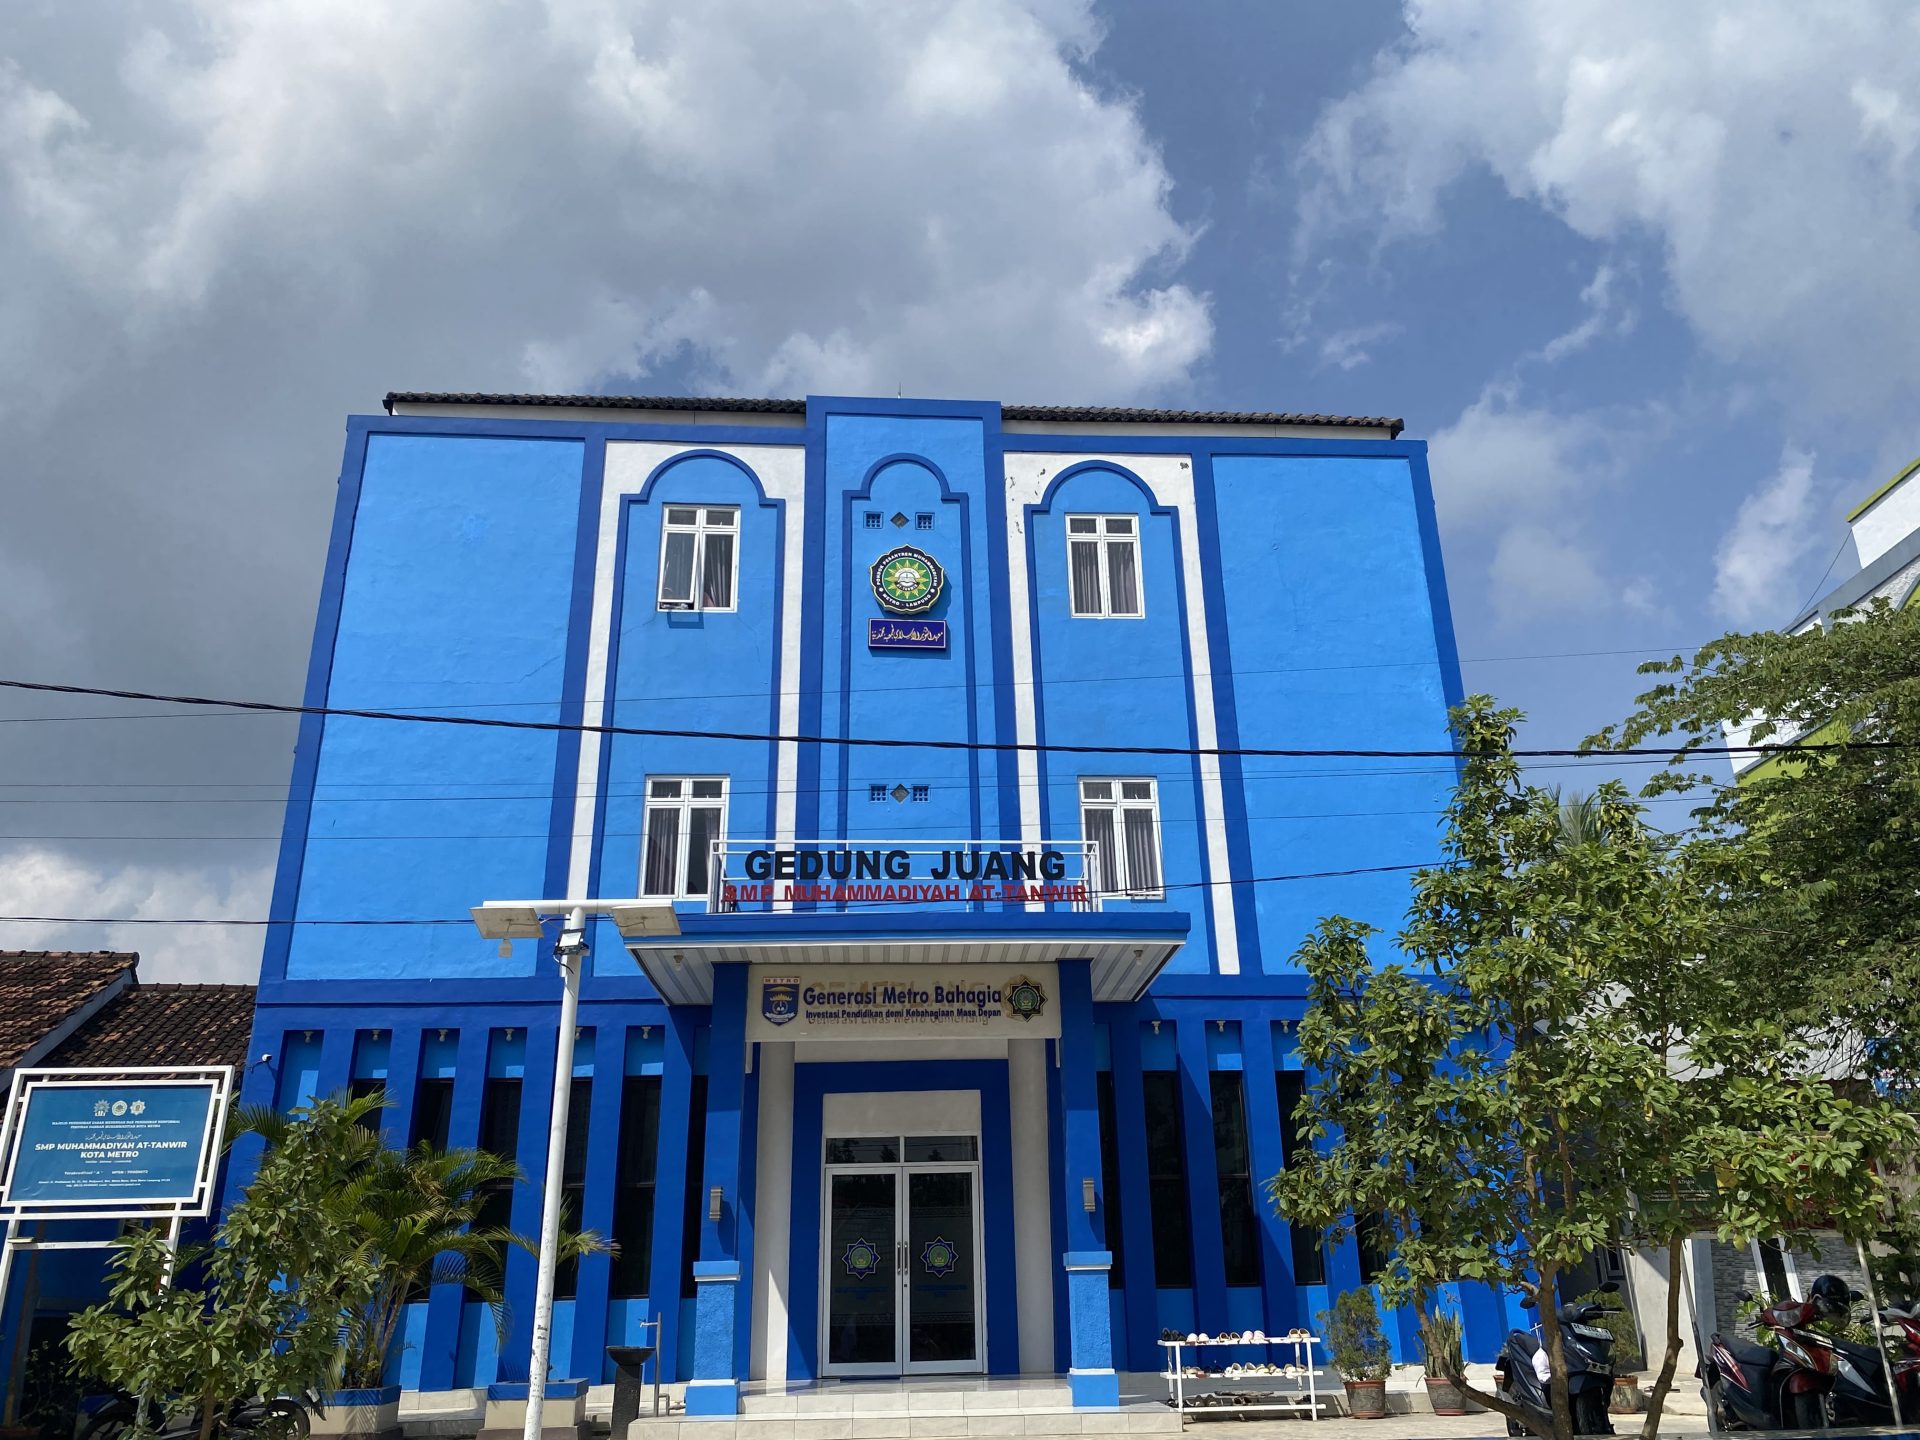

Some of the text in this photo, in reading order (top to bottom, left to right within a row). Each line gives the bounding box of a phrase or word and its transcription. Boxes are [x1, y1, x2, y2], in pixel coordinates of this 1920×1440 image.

[882, 593, 900, 605] METRO
[905, 594, 931, 607] LAMPUNG
[745, 850, 1066, 880] GEDUNG JUANG
[724, 885, 1089, 901] SMP MUHAMMADIYAH AT-TANWIR
[803, 987, 877, 1005] Generasi
[882, 987, 929, 1004] Metro
[935, 985, 1001, 1008] Bahagia
[806, 1008, 1001, 1019] Investasi Pendidikan demi Kebahagiaan Masa Depan
[56, 1142, 134, 1150] MUHAMMADIYAH
[138, 1141, 187, 1149] AT-TANWIR
[80, 1150, 139, 1159] KOTA METRO
